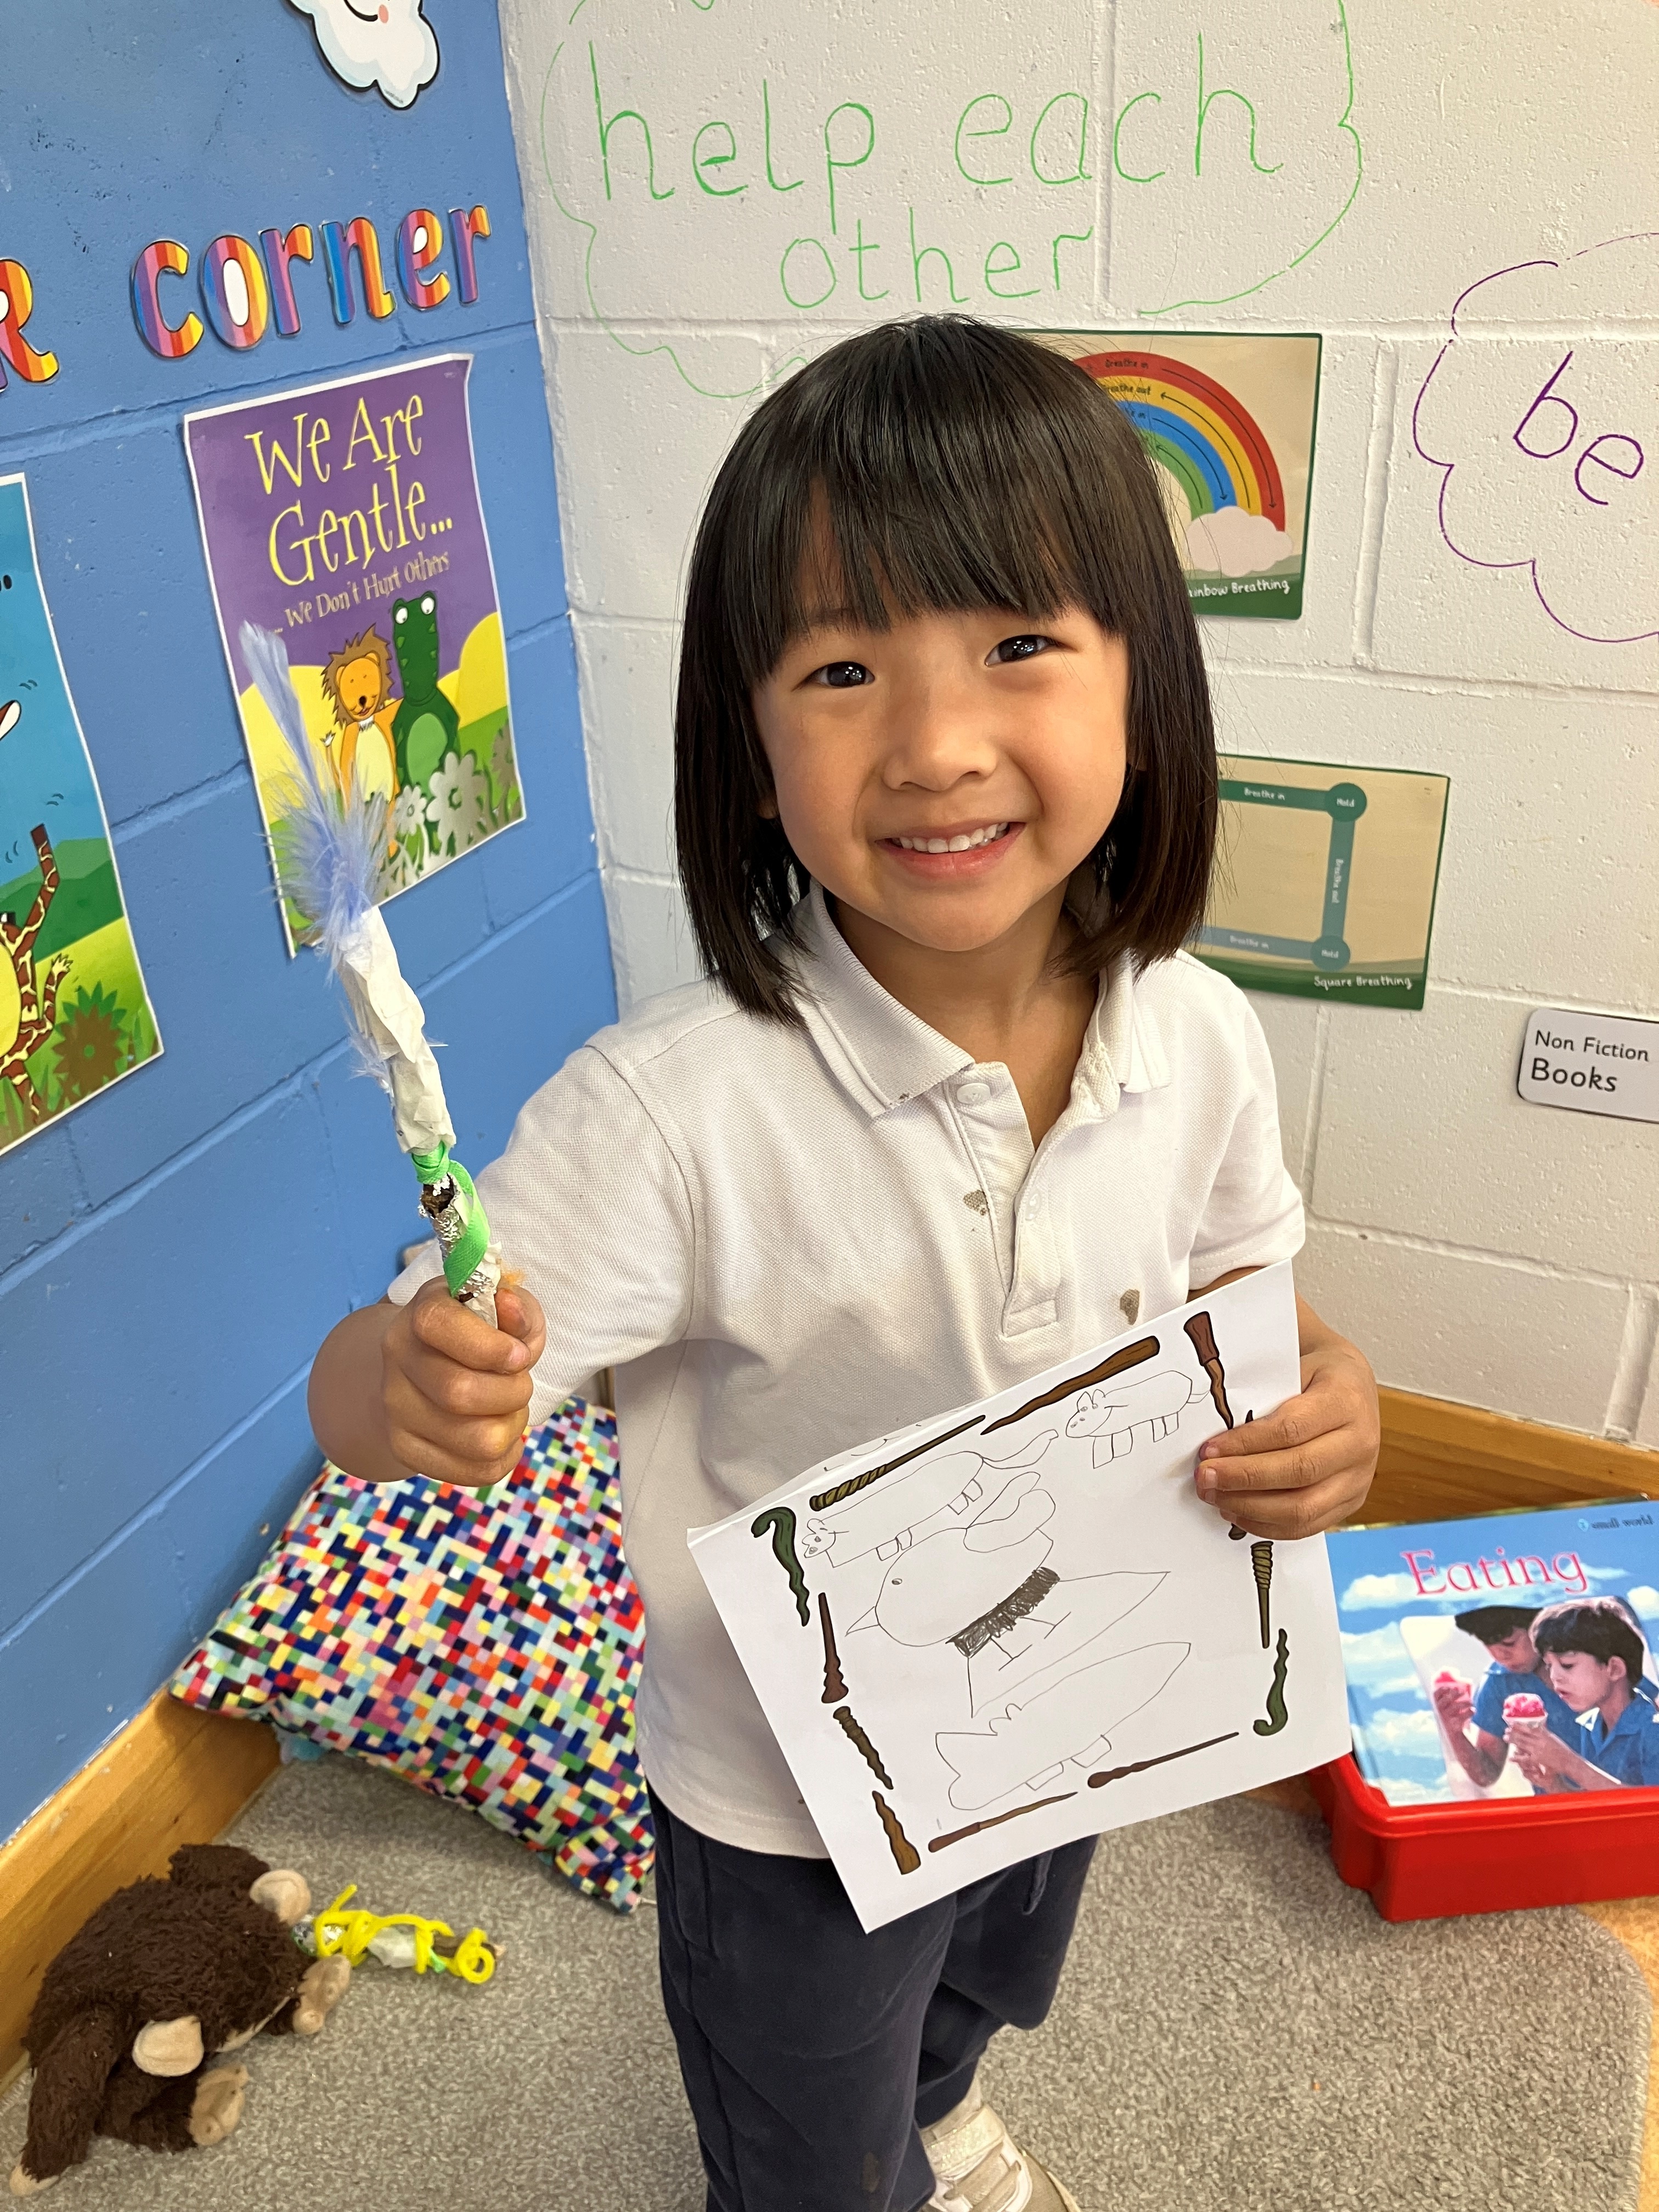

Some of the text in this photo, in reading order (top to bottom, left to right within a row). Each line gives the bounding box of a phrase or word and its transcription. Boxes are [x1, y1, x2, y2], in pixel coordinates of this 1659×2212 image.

[589, 31, 1284, 235] help each
[780, 207, 1093, 308] other
[132, 204, 491, 358] corner
[245, 394, 424, 495] We Are
[1513, 351, 1644, 505] be
[315, 580, 361, 618] Don't
[363, 566, 402, 601] Hurt
[404, 550, 450, 584] Others
[1231, 579, 1290, 594] Breathing
[1244, 787, 1274, 799] Breathe
[1336, 798, 1355, 808] Hold
[1322, 949, 1339, 958] Hold
[1314, 975, 1413, 991] Square Breathing
[1535, 1029, 1649, 1062] Non Fiction
[1531, 1057, 1617, 1092] Books
[1400, 1546, 1589, 1595] Eating
